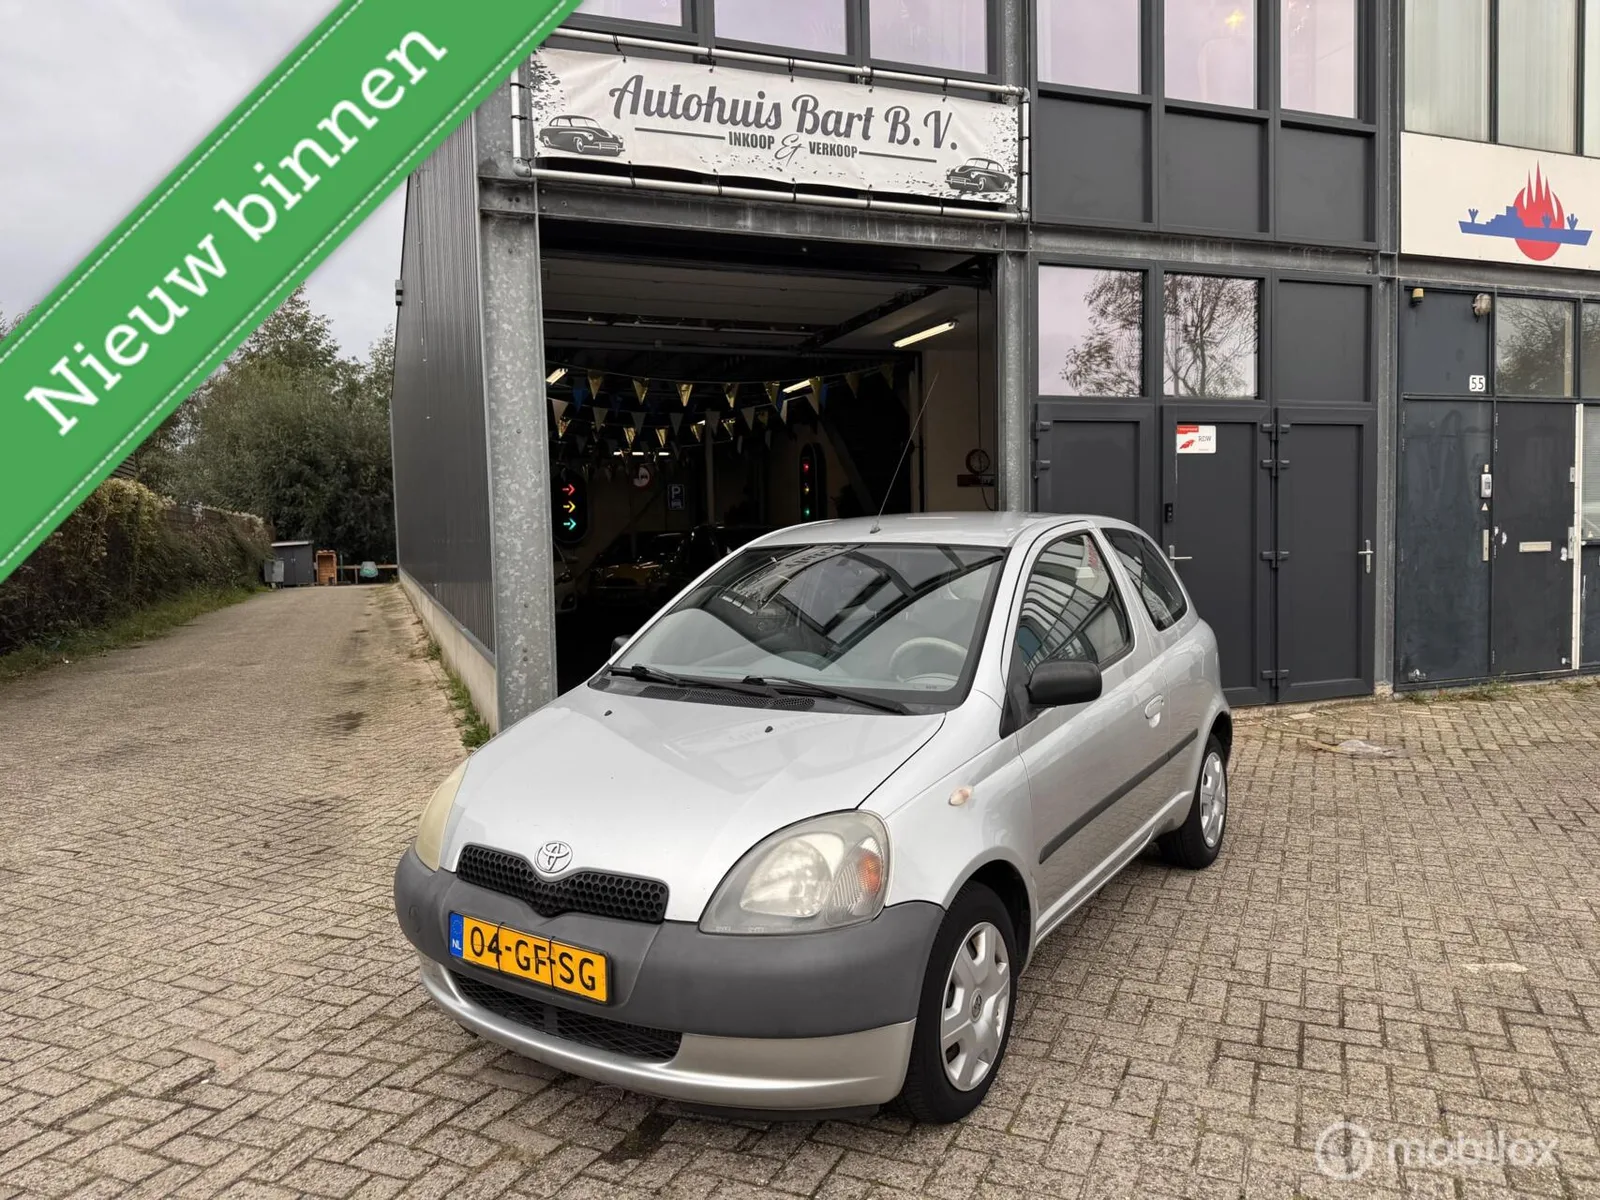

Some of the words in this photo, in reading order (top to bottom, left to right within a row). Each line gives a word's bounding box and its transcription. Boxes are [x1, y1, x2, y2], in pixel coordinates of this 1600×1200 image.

[609, 74, 783, 131] Autohuis
[791, 94, 875, 141] Bart
[884, 105, 958, 151] B.V.
[728, 131, 775, 150] INKOOP
[808, 141, 858, 158] VERKOOP
[1471, 377, 1485, 390] 55
[452, 938, 462, 951] NL
[470, 926, 596, 991] 04-GF-SG
